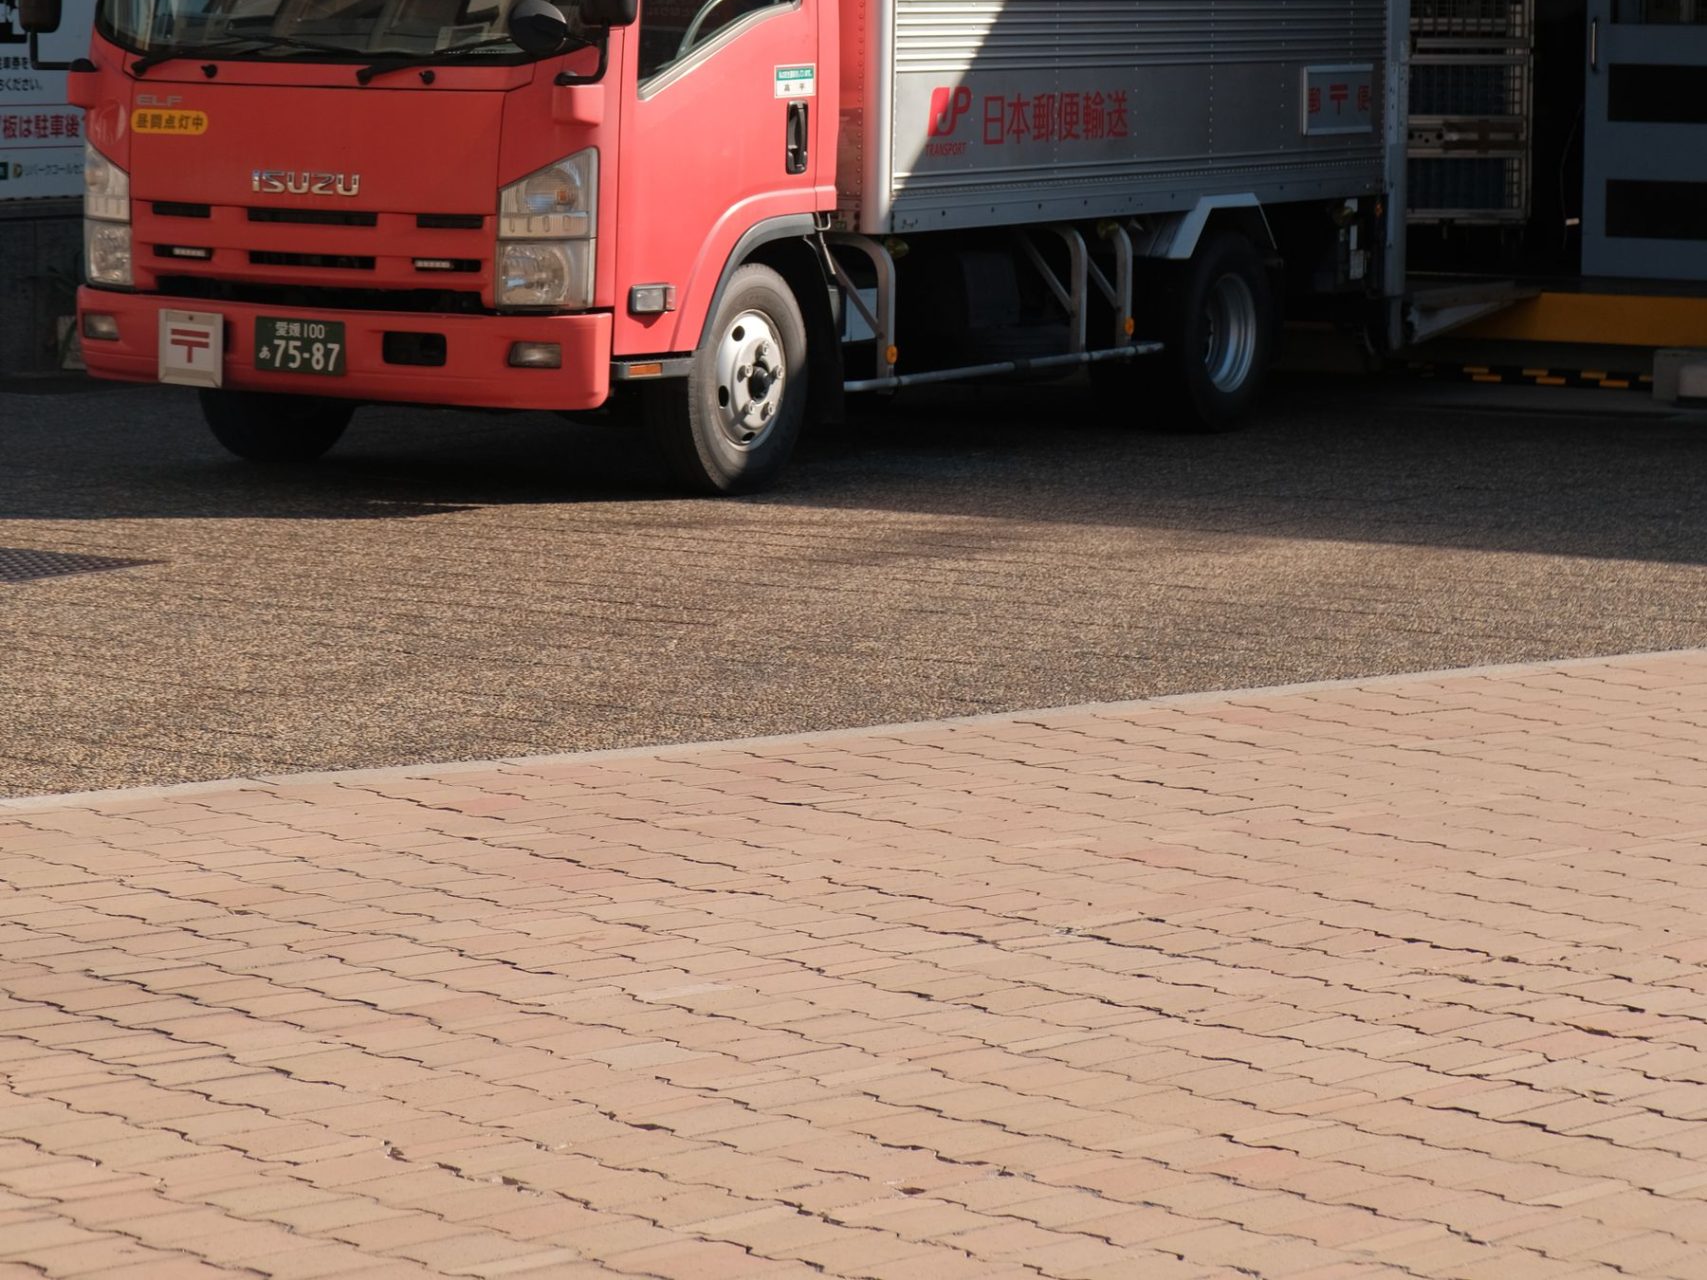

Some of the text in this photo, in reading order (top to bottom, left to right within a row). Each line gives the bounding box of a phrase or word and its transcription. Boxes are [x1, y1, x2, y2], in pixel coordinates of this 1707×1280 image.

[0, 57, 29, 70] 車券を
[136, 94, 183, 107] ELF
[983, 90, 1129, 145] 日本郵便輸送
[925, 142, 967, 156] TRANSPORT
[252, 170, 360, 197] ISUZU
[275, 321, 325, 339] 愛媛 100
[258, 339, 341, 372] あ 75-87
